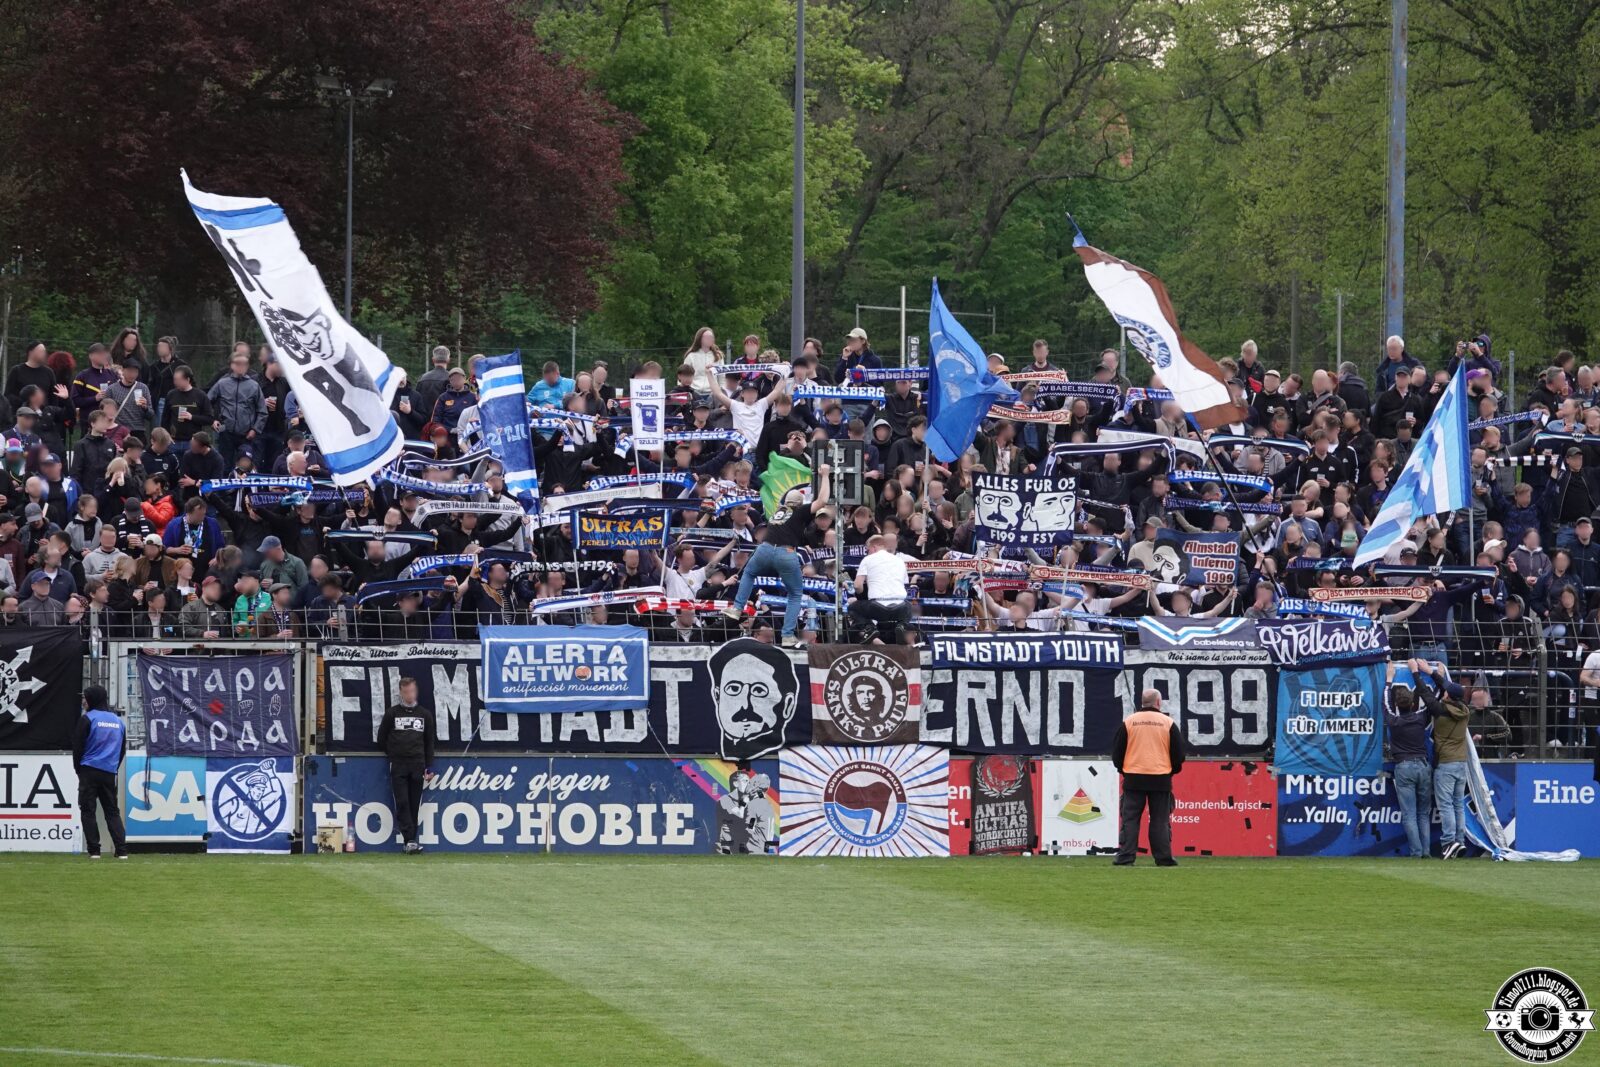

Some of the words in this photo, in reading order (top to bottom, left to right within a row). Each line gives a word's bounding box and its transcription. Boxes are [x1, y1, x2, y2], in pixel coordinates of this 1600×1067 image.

[797, 385, 885, 398] BABELSBERG
[1050, 385, 1105, 395] BABELSBERG
[211, 476, 308, 489] BABELSBERG
[589, 472, 687, 491] BABELSBERG
[975, 475, 1019, 492] ALLES
[1025, 478, 1053, 492] FÜR
[581, 516, 664, 533] ULTRAS
[1033, 532, 1057, 544] FSY
[1192, 556, 1236, 571] Inferno
[1204, 571, 1235, 585] 1999
[1330, 589, 1343, 598] BSG
[1344, 588, 1369, 597] MOTOR
[1369, 587, 1412, 596] BABELSBERG
[933, 640, 1044, 663] FILMSTADT
[1050, 640, 1120, 663] YOUTH
[1193, 639, 1245, 647] babelsberg
[407, 646, 459, 658] Babelsberg
[503, 643, 628, 666] ALERTA
[1168, 651, 1183, 660] Noi
[1185, 652, 1209, 661] siamo
[1211, 653, 1220, 661] la
[1248, 653, 1269, 661] nord
[502, 682, 565, 696] antifascist
[568, 682, 630, 693] movement
[1114, 667, 1268, 746] 1999
[1301, 690, 1317, 707] FI
[827, 680, 865, 737] SANKT
[872, 689, 908, 738] PAULI
[1287, 715, 1318, 735] FÜR
[1319, 717, 1375, 735] IMMER!
[423, 766, 516, 791] ulldrei
[526, 775, 611, 800] gegen
[860, 763, 887, 776] SANKT
[886, 773, 902, 795] PAULI
[1285, 775, 1386, 801] Mitglied
[1532, 780, 1595, 804] Eine
[975, 800, 1027, 819] ANTIFA
[975, 814, 1027, 833] ULTRAS
[1063, 837, 1097, 847] mbs.de
